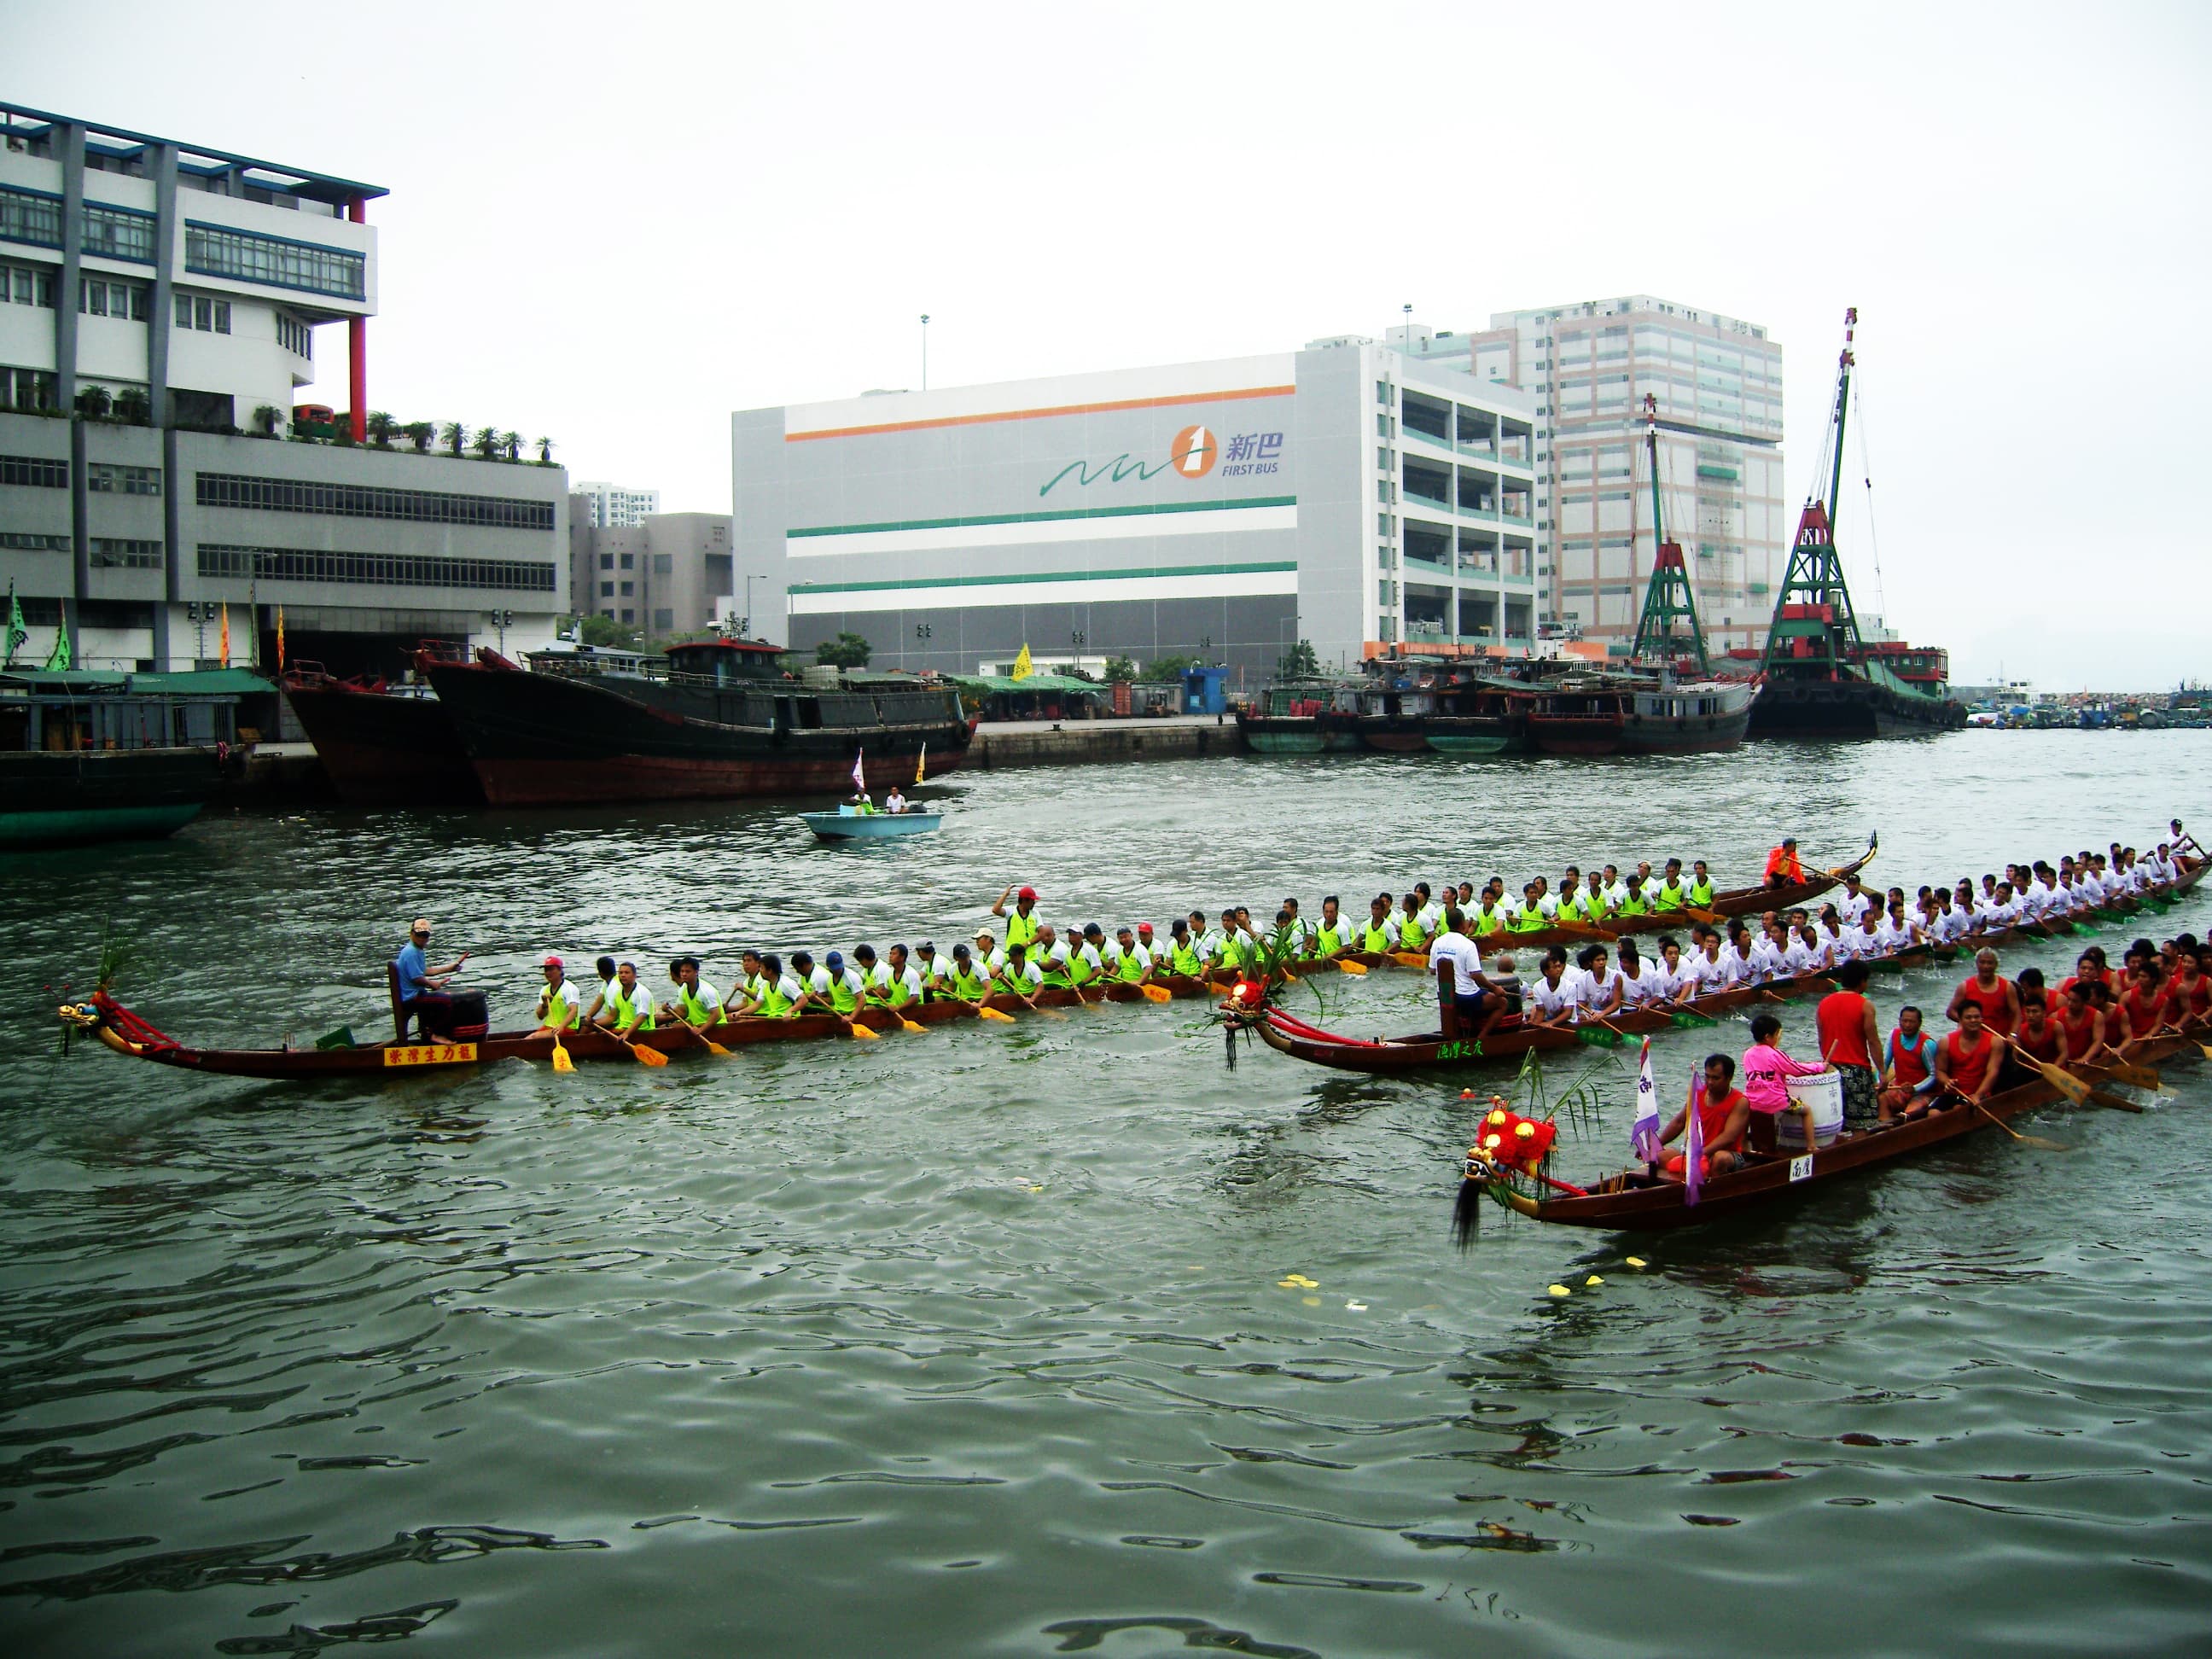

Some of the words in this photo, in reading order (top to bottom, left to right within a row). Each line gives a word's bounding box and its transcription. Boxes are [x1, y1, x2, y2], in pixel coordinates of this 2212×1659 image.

[1226, 432, 1284, 461] 新巴
[1222, 463, 1254, 477] FIRST
[1254, 462, 1278, 474] BUS
